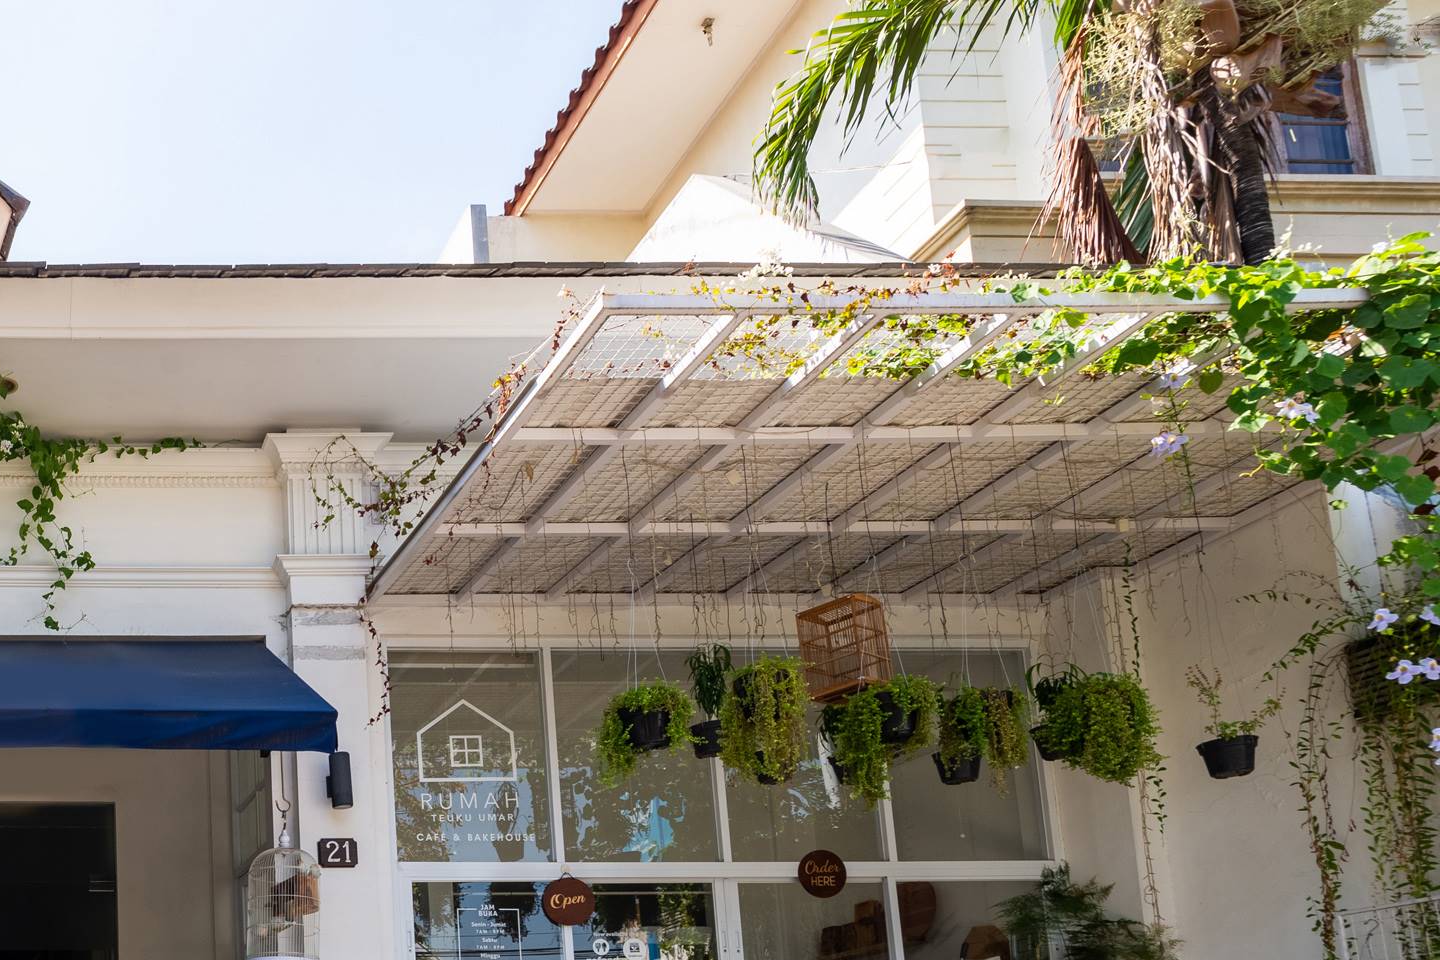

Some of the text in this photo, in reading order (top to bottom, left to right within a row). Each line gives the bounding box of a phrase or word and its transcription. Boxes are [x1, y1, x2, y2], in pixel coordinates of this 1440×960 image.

[421, 791, 519, 810] RUMAH
[431, 813, 514, 822] TEUKU UMAR
[467, 833, 536, 842] BAKEHOUSE
[326, 840, 351, 863] 21
[805, 859, 839, 875] Order
[811, 875, 836, 887] HERE
[550, 893, 586, 910] Open
